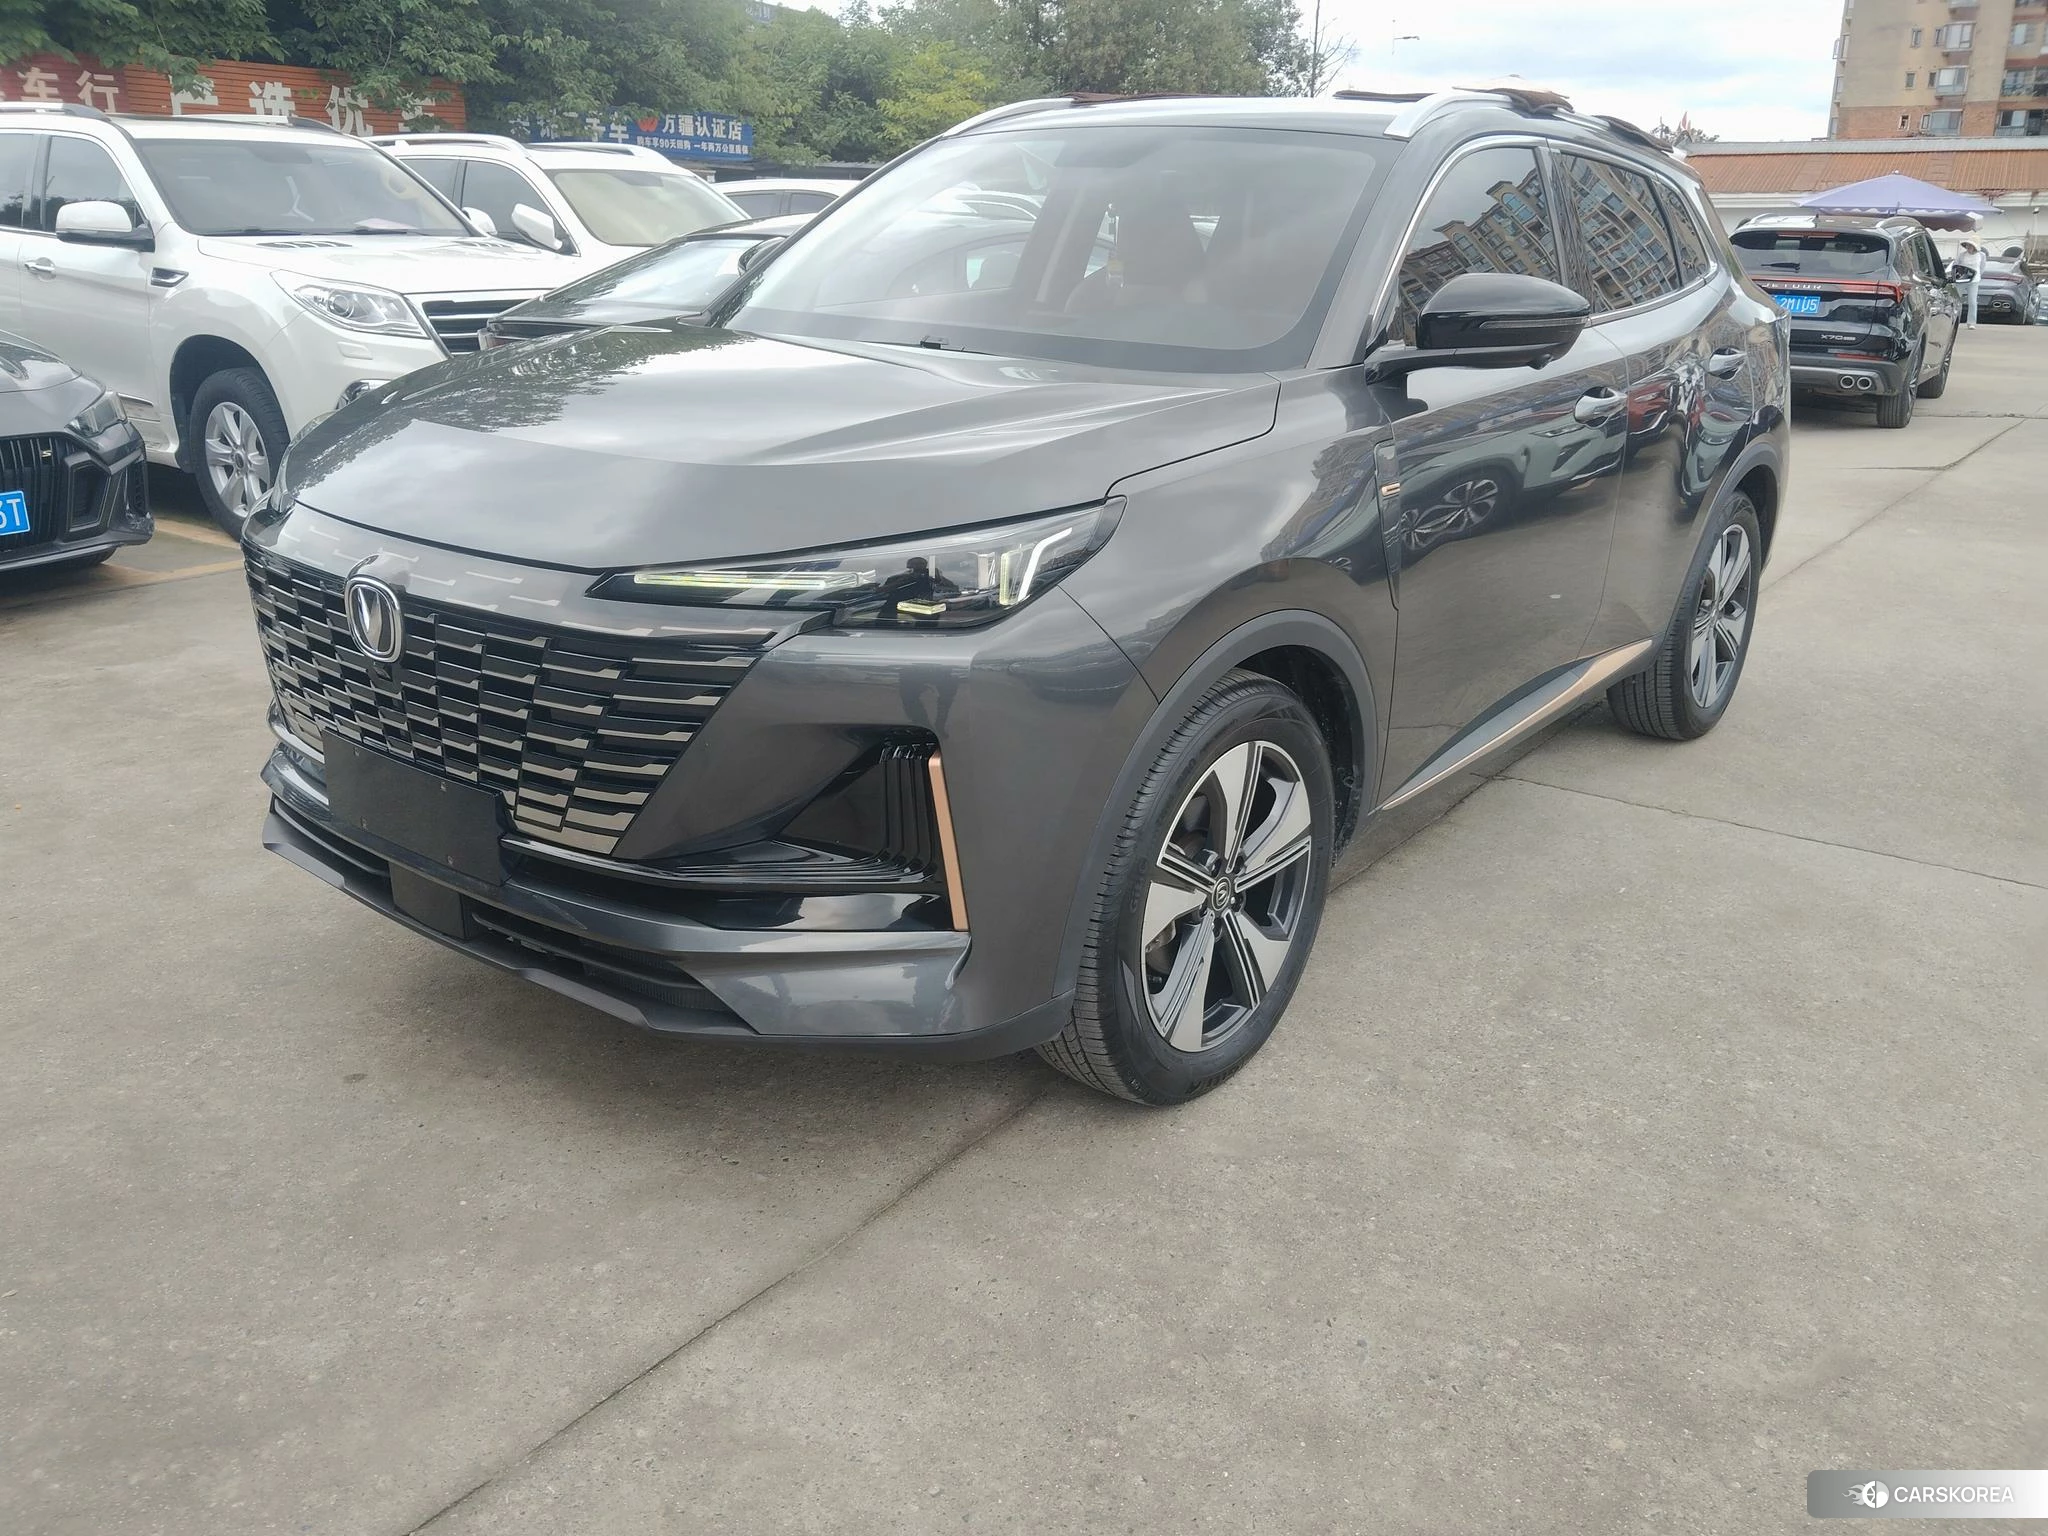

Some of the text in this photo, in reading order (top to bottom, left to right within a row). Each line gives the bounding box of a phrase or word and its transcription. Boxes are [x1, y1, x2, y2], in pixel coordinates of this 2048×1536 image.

[0, 66, 119, 114] 车行
[662, 113, 742, 141] 万疆认证店
